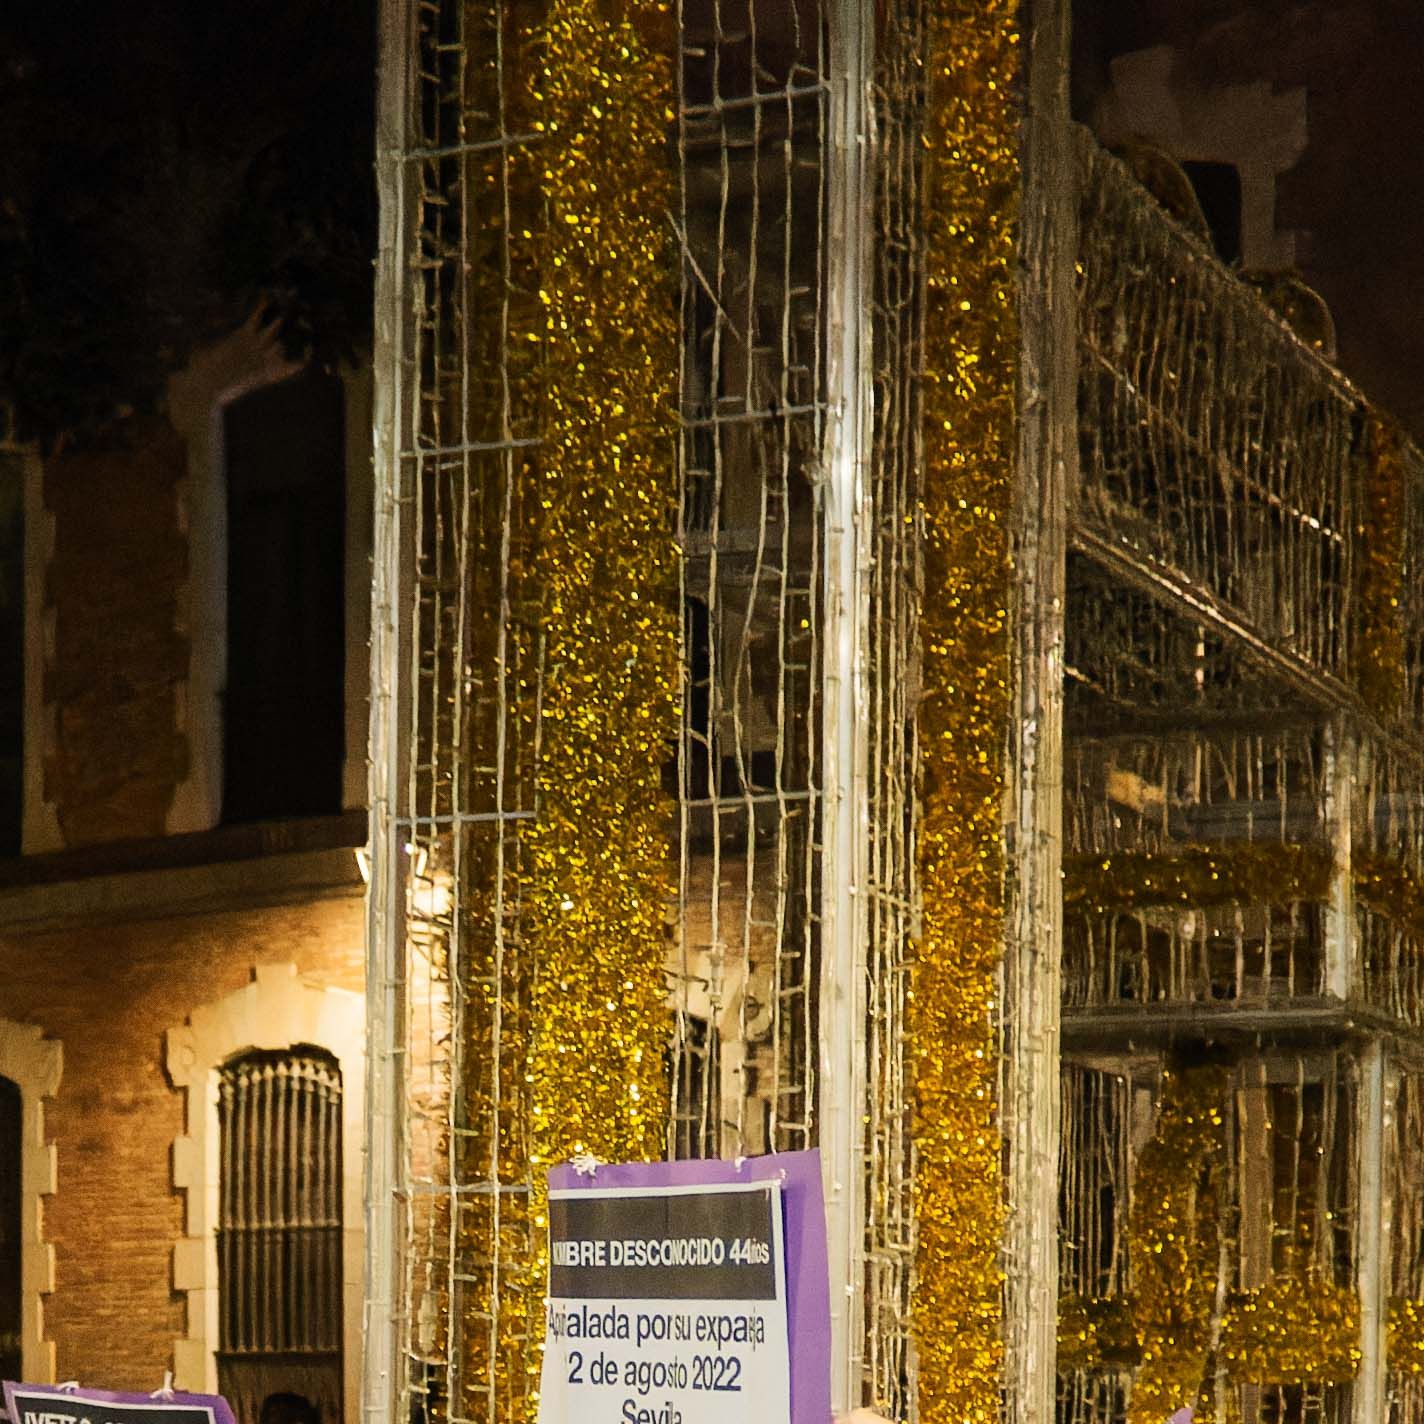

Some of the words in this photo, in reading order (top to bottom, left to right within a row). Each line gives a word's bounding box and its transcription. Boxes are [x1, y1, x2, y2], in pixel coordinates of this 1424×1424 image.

[610, 1238, 725, 1267] DESCONOCIDO
[636, 1312, 673, 1348] por
[675, 1314, 691, 1342] su
[590, 1351, 619, 1386] de
[624, 1355, 688, 1396] agosto
[692, 1354, 742, 1392] 2022
